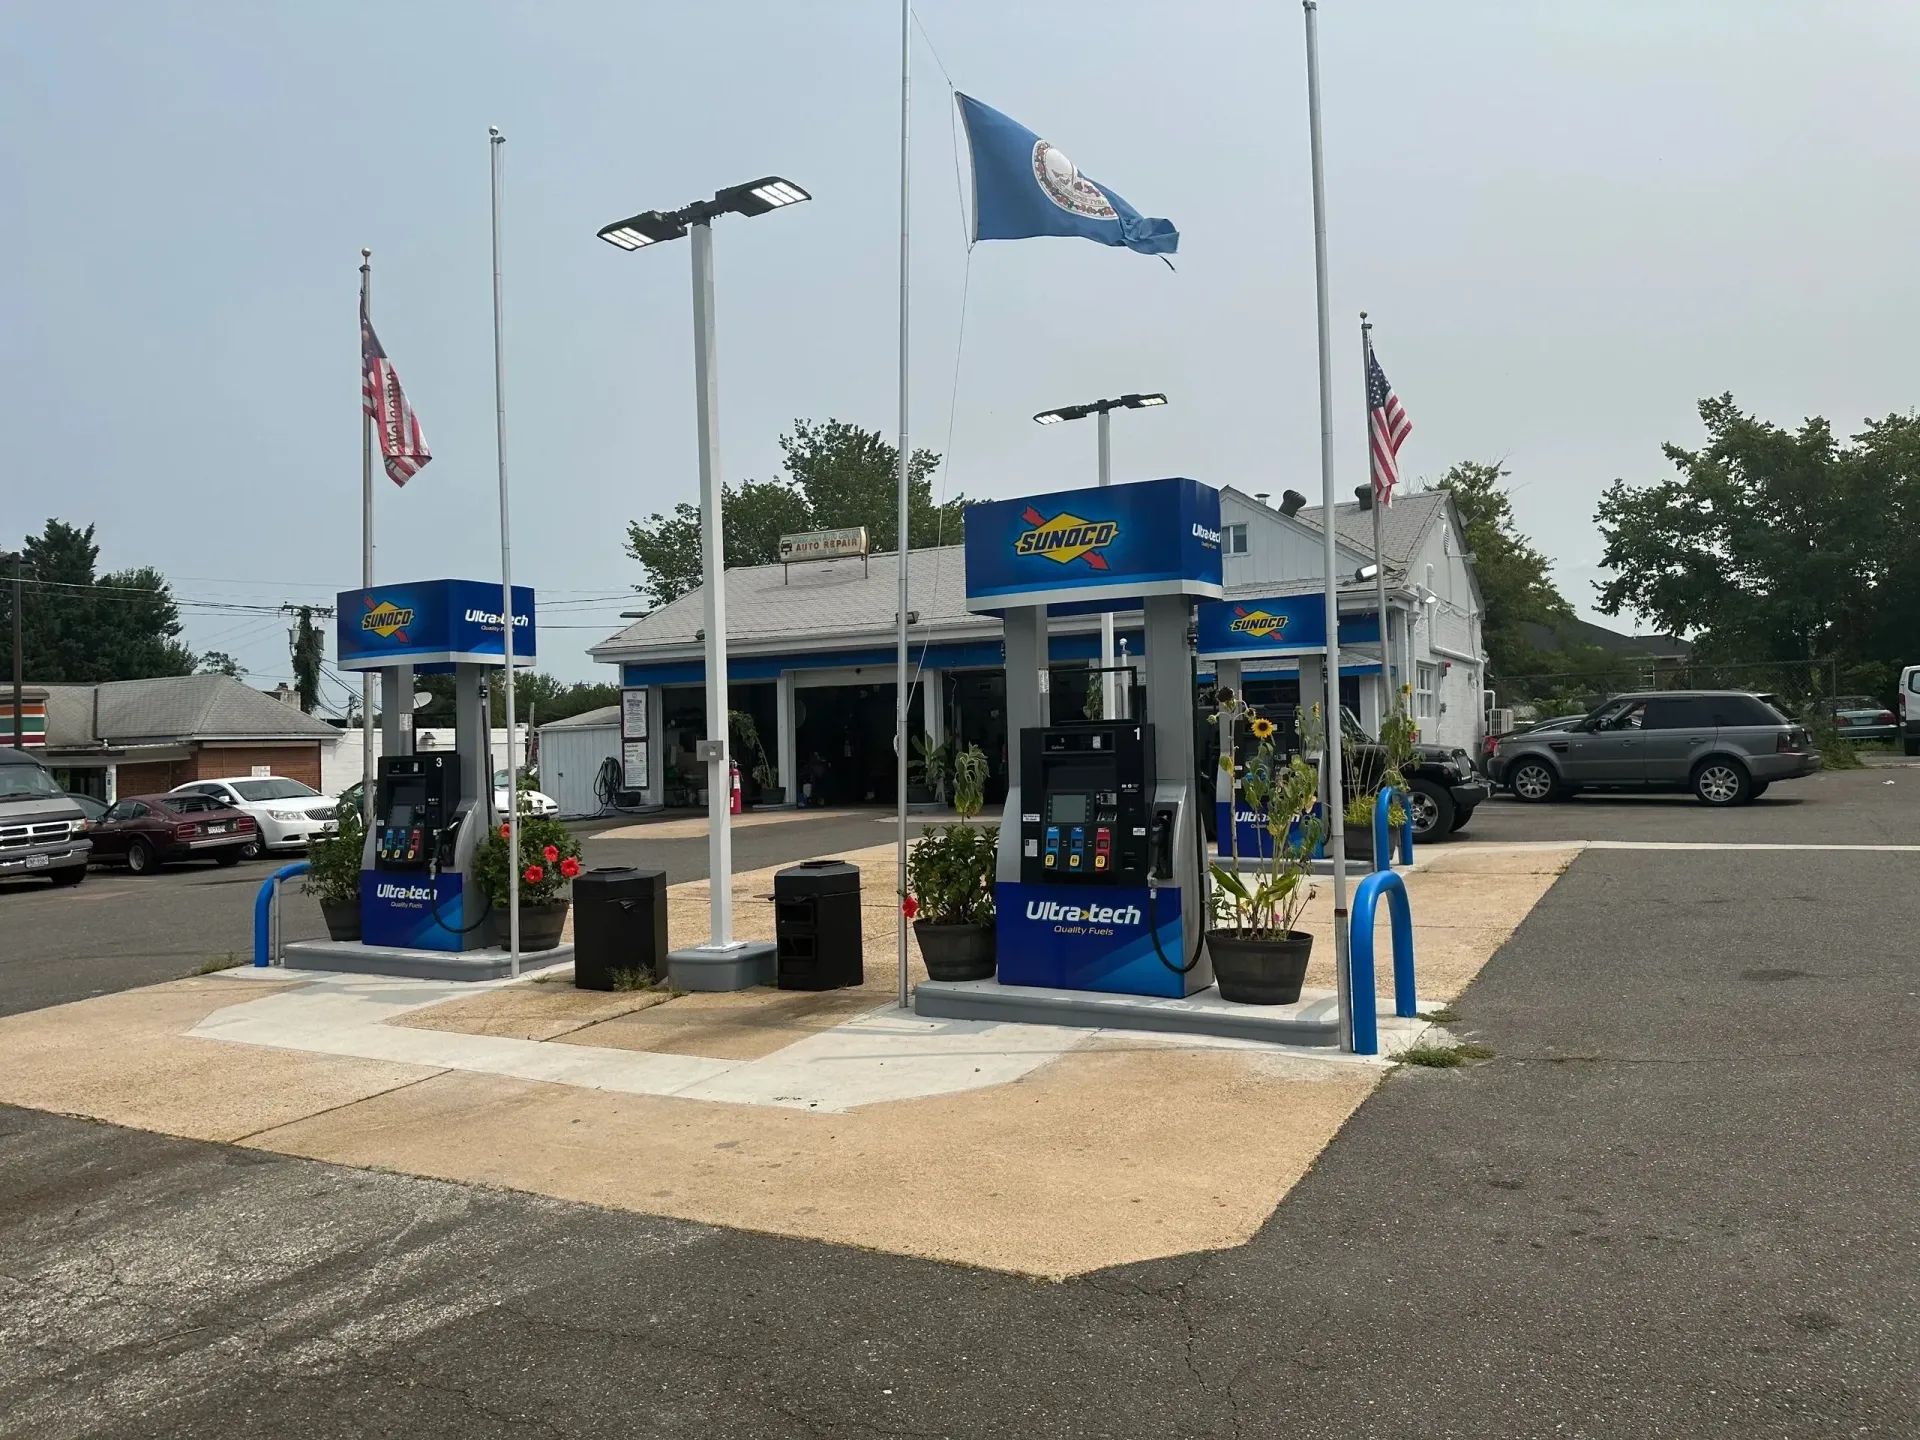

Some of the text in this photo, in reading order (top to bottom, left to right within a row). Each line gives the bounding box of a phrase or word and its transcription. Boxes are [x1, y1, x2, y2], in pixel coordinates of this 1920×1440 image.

[796, 542, 819, 552] AUTO
[823, 538, 857, 549] REPAIR
[1019, 524, 1114, 553] SUNOCO
[363, 610, 412, 629] SUNOCO
[1232, 617, 1287, 630] SUNOCO
[1134, 727, 1141, 741] 1
[435, 757, 443, 768] 3
[390, 901, 409, 909] Quality
[1054, 925, 1114, 936] Quality Fuels
